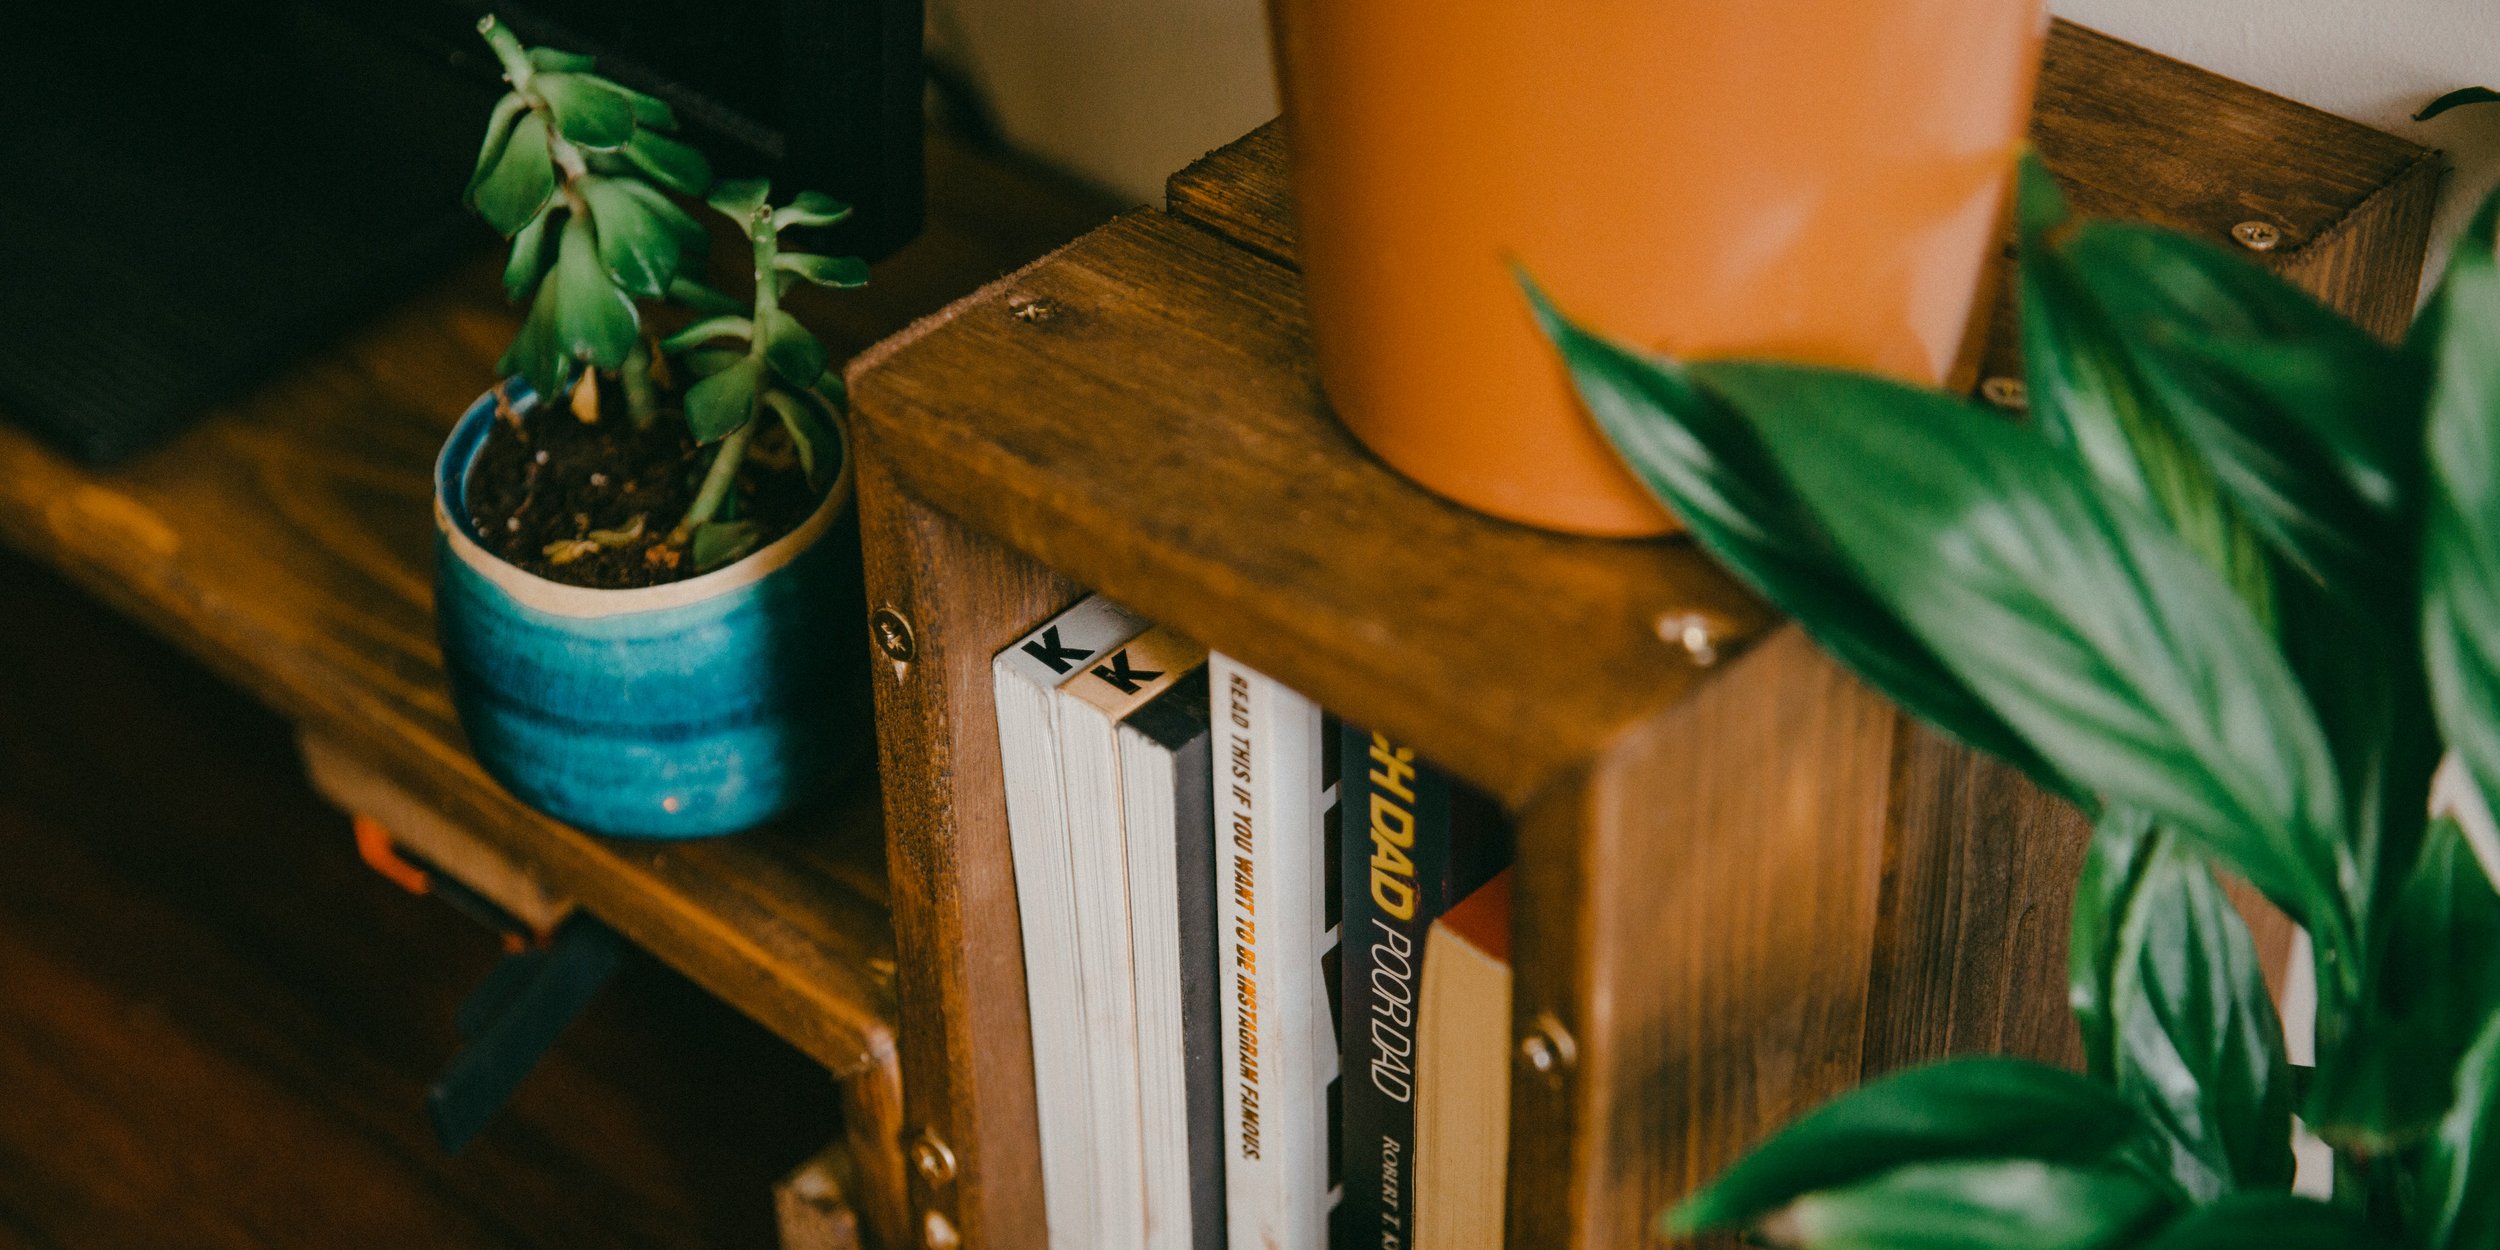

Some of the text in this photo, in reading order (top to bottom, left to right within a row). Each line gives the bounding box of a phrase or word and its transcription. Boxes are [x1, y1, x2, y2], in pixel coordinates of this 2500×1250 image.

[1021, 625, 1095, 674] K
[1090, 648, 1165, 694] K
[1369, 792, 1415, 922] DAD
[1231, 673, 1260, 1161] READ THIS IF YOU WANT TO BE INSTAGRAM FAMOUS.
[1371, 918, 1411, 1028] POOR
[1371, 1018, 1411, 1103] DAD
[1382, 1135, 1400, 1211] ROBERT
